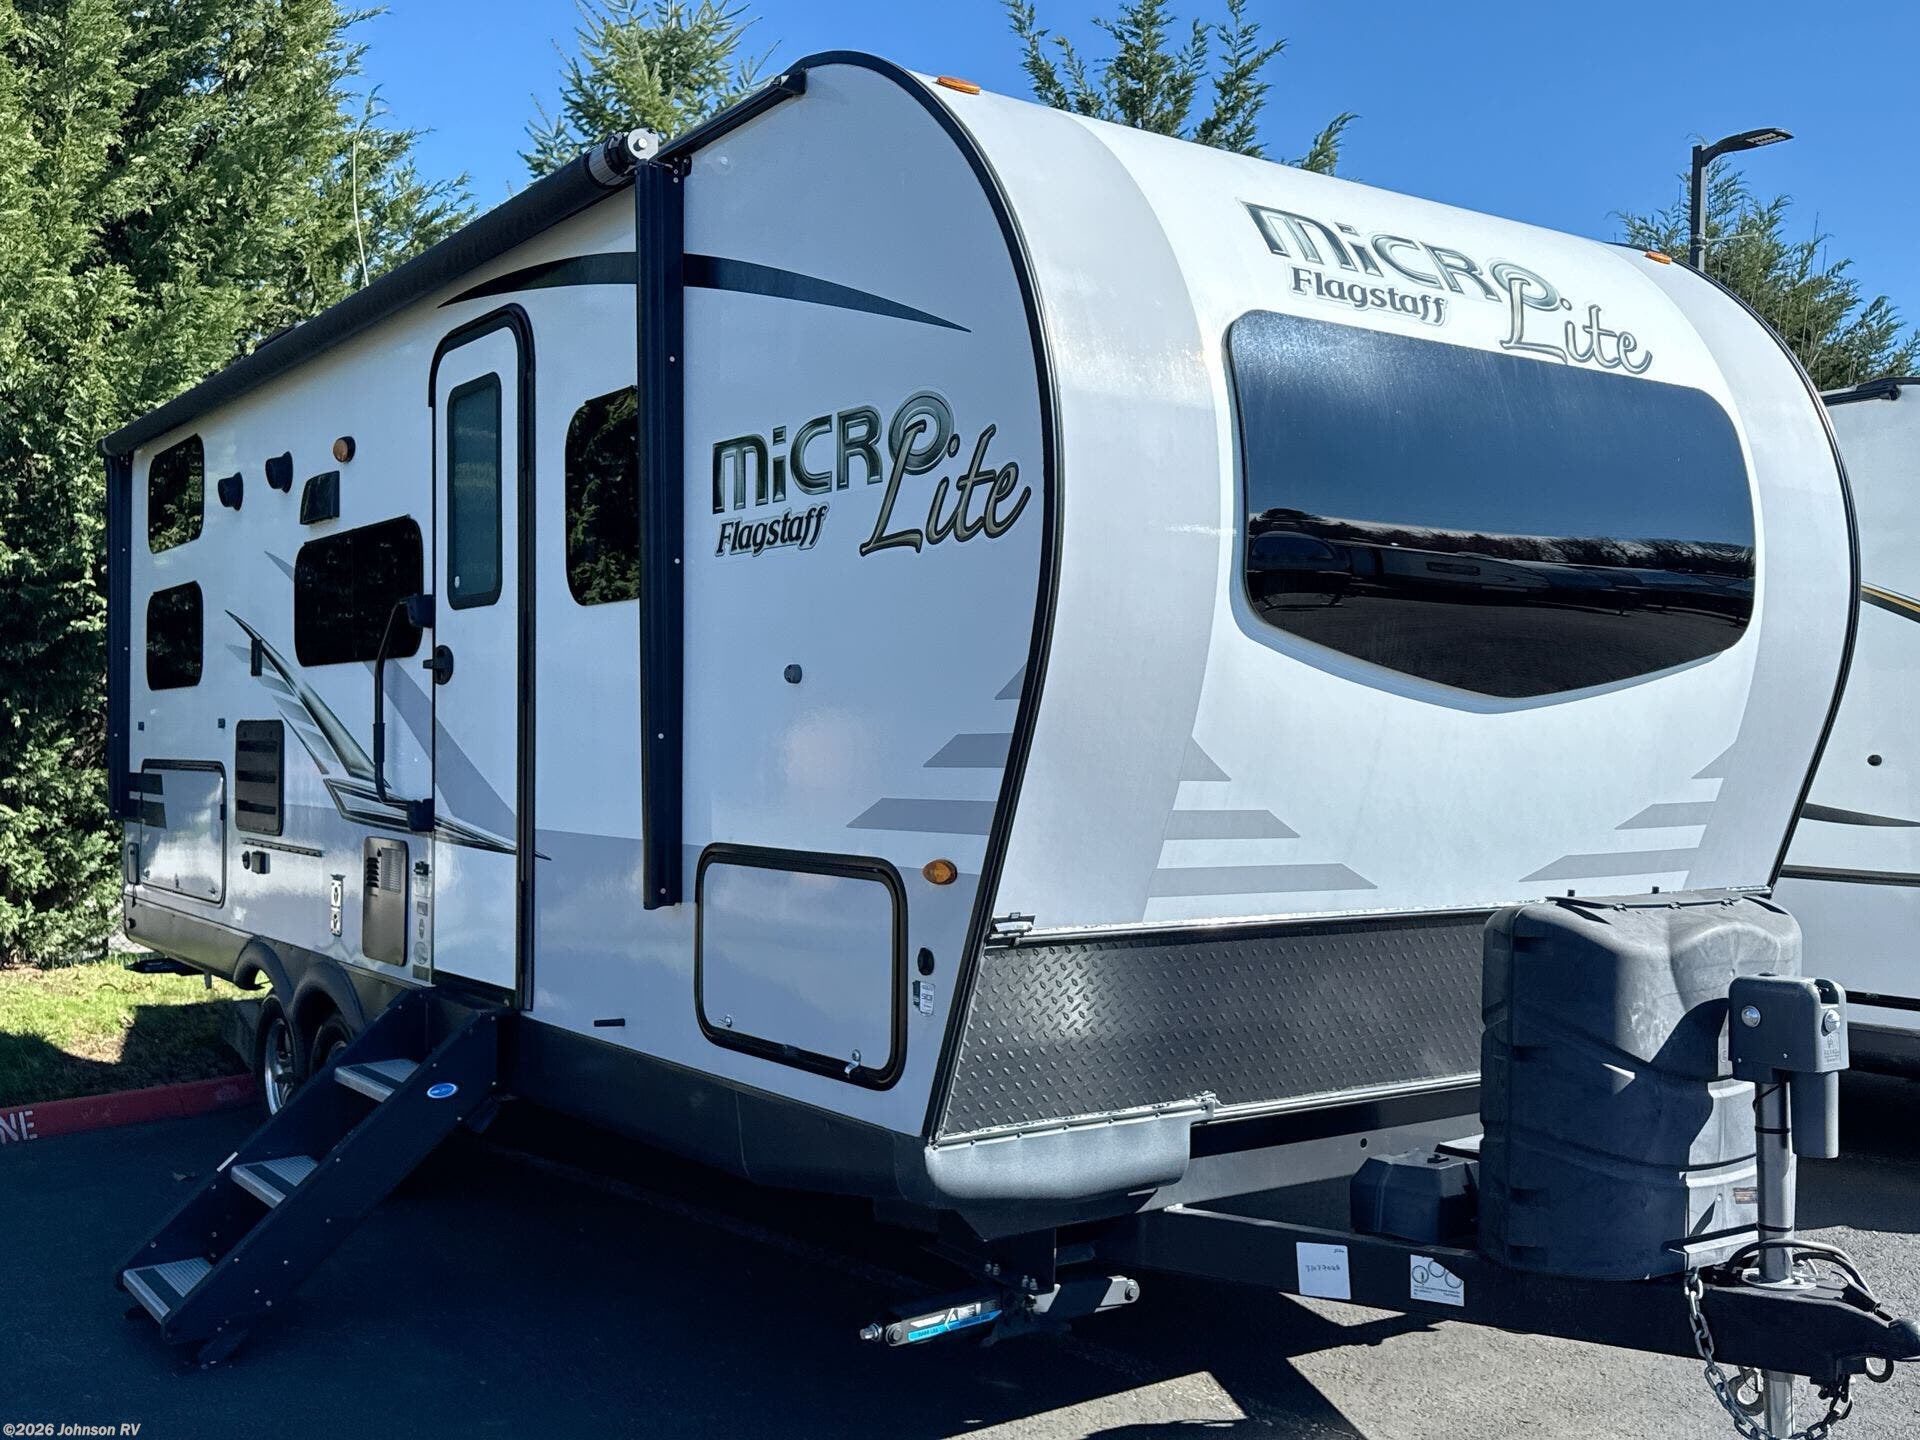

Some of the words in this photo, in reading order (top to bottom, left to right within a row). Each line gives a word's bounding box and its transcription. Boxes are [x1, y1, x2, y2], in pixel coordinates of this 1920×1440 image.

[1291, 266, 1447, 325] Flagstaff
[1500, 276, 1653, 375] Lite
[859, 419, 1033, 558] Lite
[715, 505, 829, 556] Flagstaff
